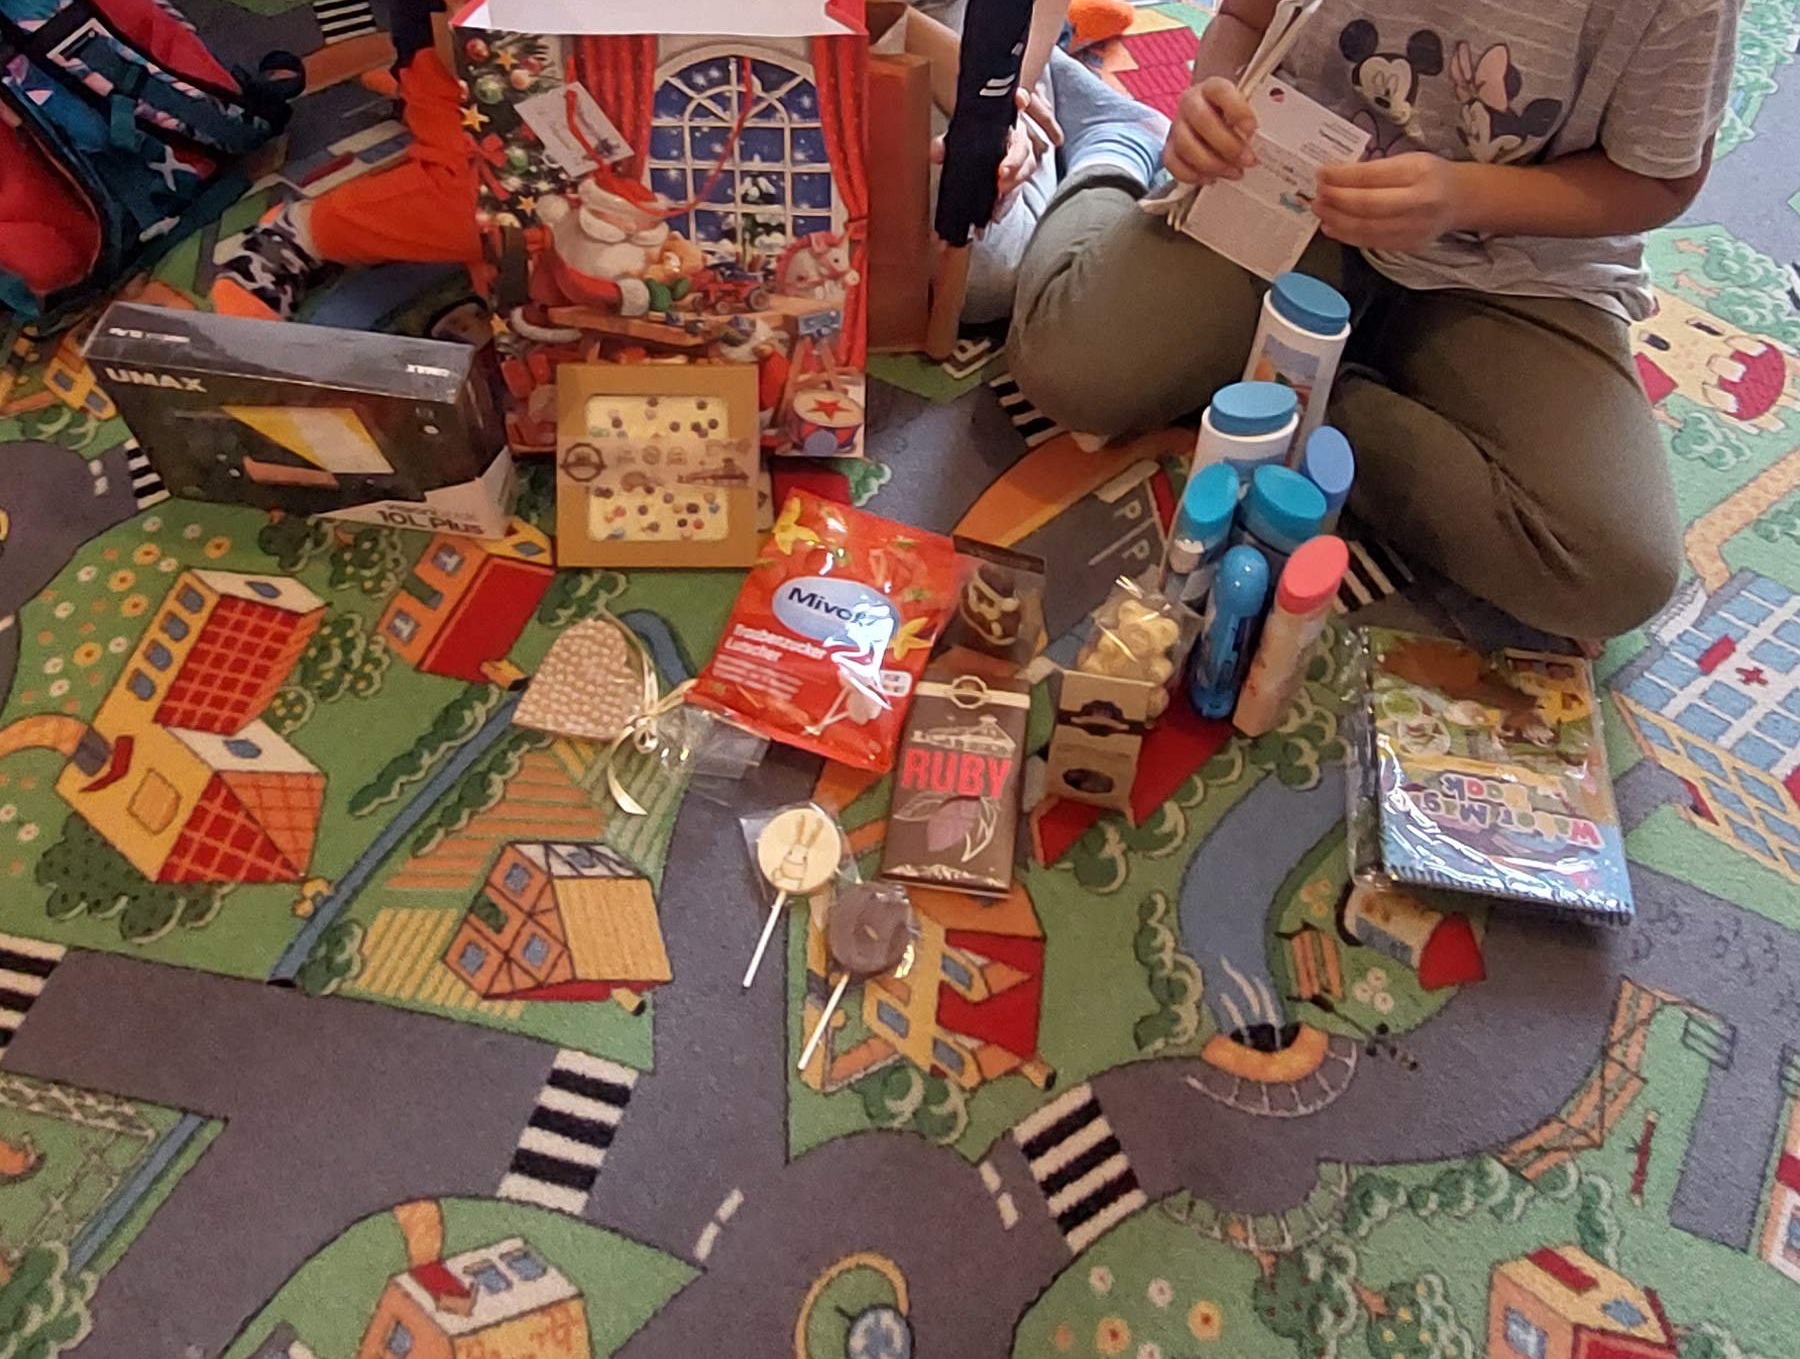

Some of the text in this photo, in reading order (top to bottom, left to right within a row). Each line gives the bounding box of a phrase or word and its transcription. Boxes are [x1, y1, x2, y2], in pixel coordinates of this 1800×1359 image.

[105, 367, 208, 393] UMAX
[376, 509, 428, 529] 10L
[429, 517, 485, 535] Plus
[902, 747, 1012, 800] RUBY
